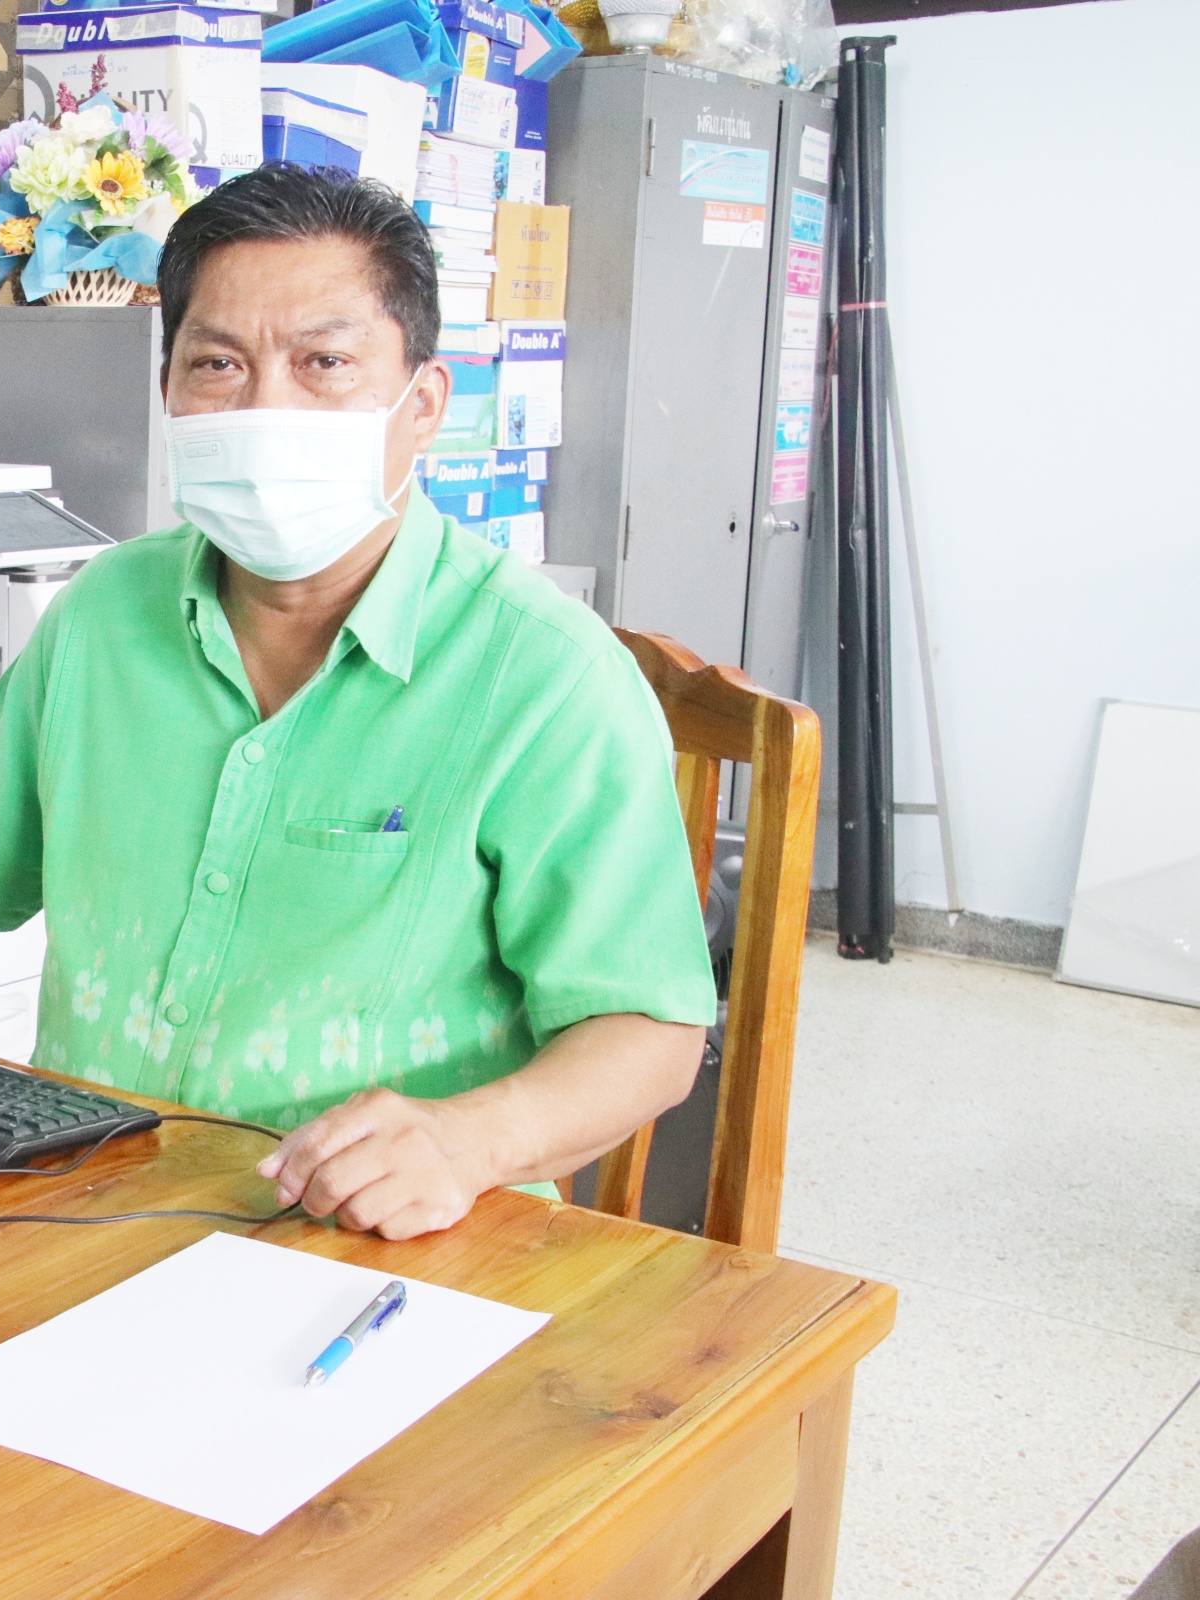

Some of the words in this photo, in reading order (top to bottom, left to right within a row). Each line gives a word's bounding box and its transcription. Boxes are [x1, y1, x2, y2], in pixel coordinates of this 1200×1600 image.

[467, 5, 495, 27] Double
[496, 17, 503, 30] A
[35, 18, 119, 45] Double
[131, 17, 147, 36] A
[189, 17, 239, 39] Double
[243, 23, 253, 39] A
[696, 106, 751, 144] พัฒนาชุมชน
[220, 153, 258, 166] QUALITY
[511, 332, 549, 350] Double
[550, 333, 560, 349] A
[437, 464, 479, 482] Double
[479, 463, 490, 479] A
[494, 461, 518, 476] ouble
[518, 460, 526, 473] A
